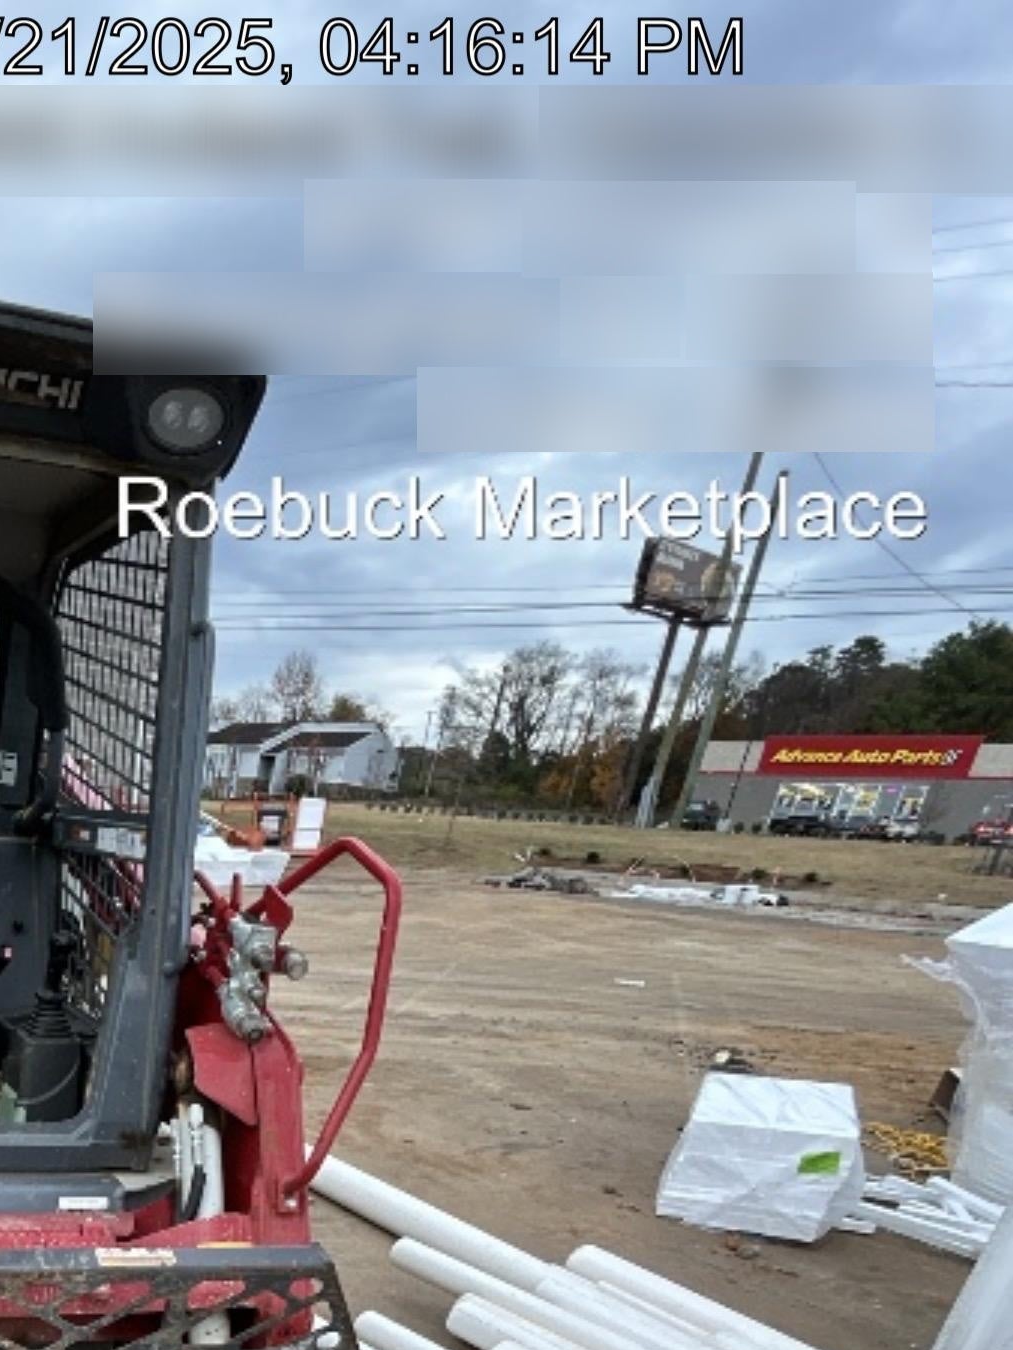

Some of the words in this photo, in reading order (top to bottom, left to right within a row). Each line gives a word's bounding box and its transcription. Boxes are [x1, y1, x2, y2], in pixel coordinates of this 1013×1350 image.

[770, 748, 842, 764] Advance
[843, 749, 890, 764] Auto
[891, 749, 942, 766] Parts
